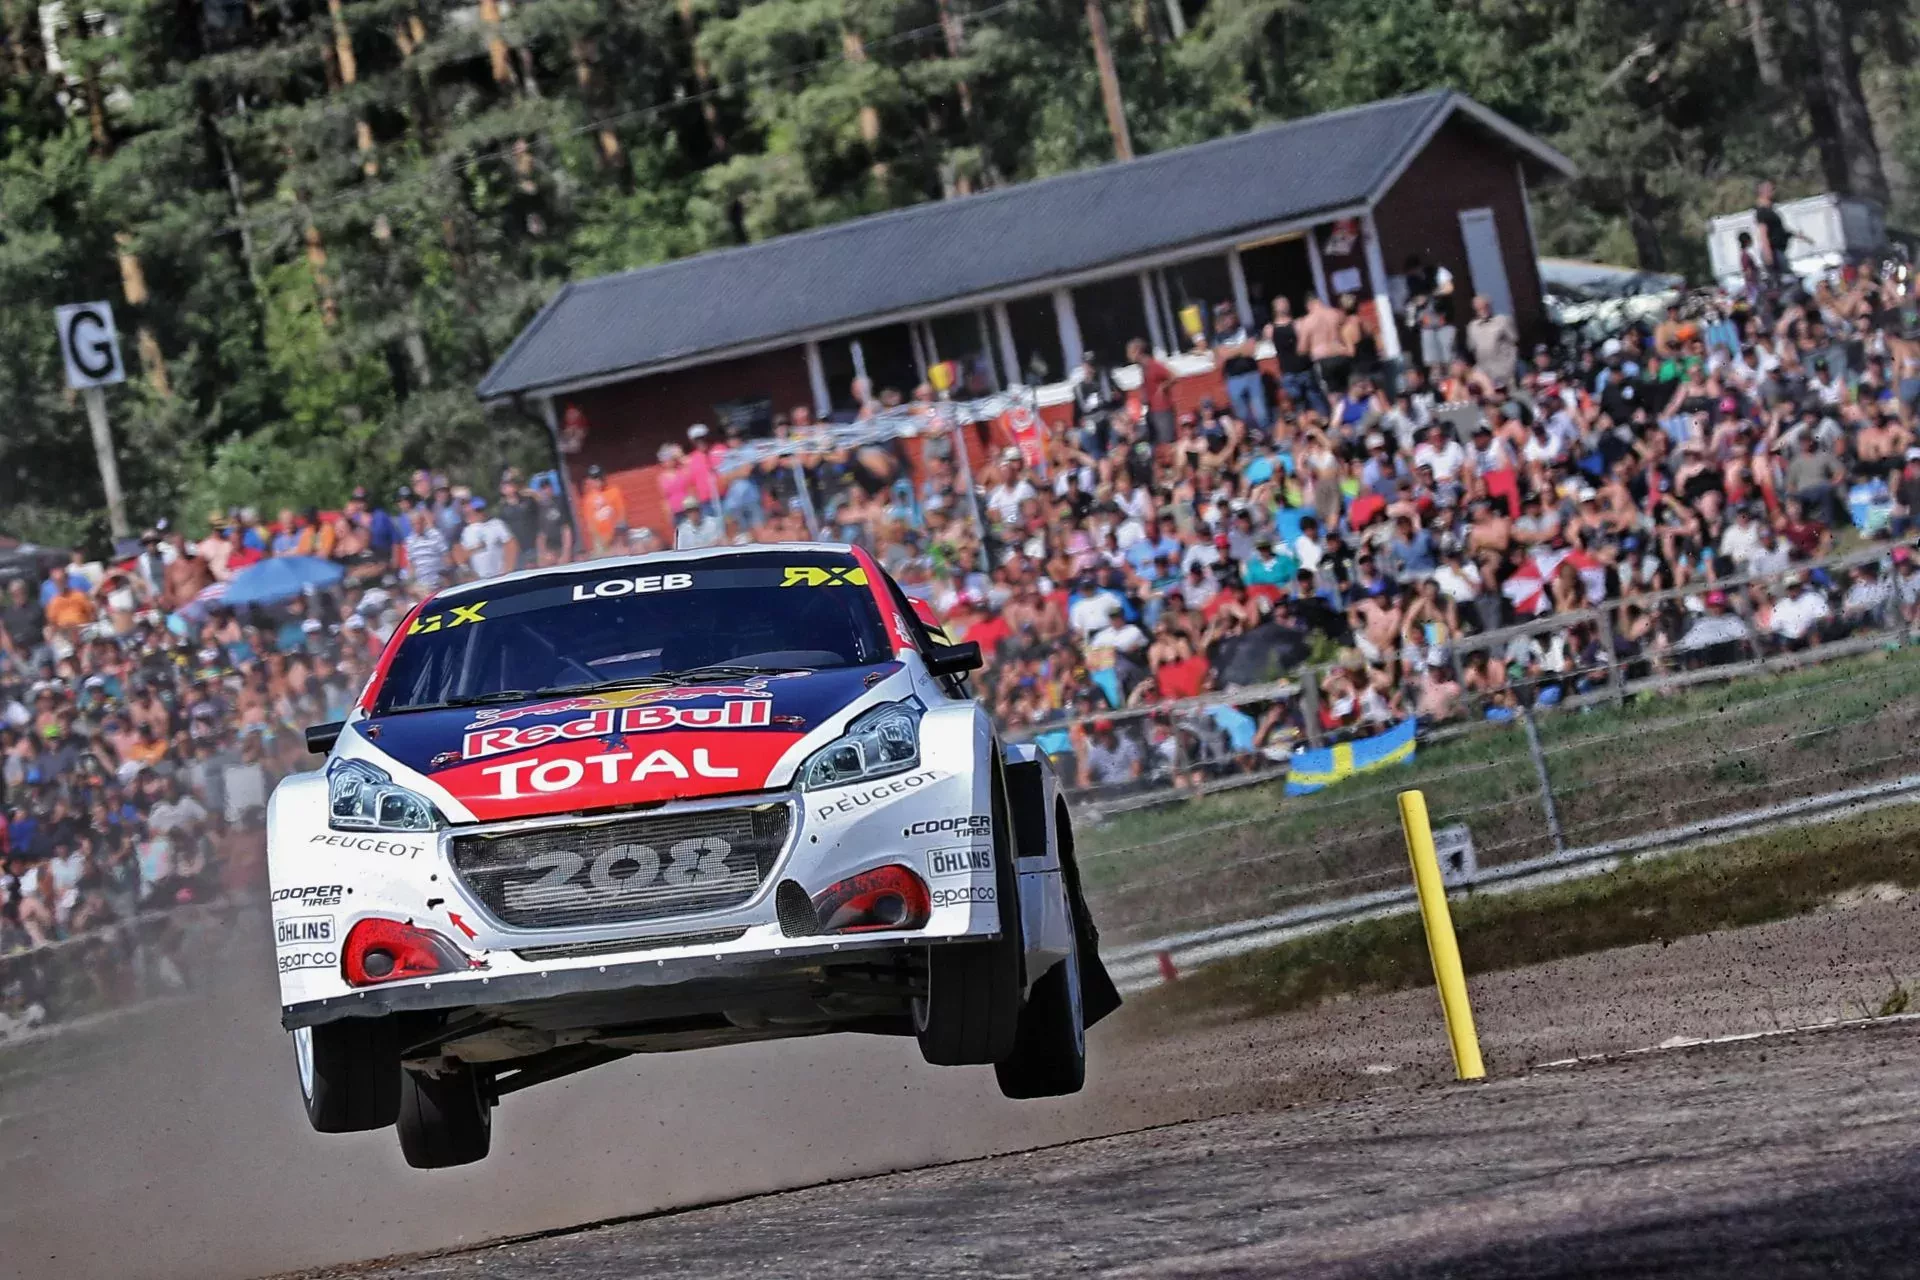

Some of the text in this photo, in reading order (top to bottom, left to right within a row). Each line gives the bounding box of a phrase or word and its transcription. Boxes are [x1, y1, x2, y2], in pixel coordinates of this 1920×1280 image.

[69, 311, 114, 378] G
[573, 573, 692, 600] LOEB
[463, 700, 771, 760] Red Bull
[482, 749, 738, 800] TOTAL
[818, 770, 938, 820] PEUGEOT
[911, 815, 990, 836] COOPER
[954, 827, 990, 839] TIRES
[310, 834, 425, 859] PEUGEOT
[513, 837, 731, 910] 208
[933, 850, 990, 874] ÖHLINS
[272, 885, 343, 902] COOPER
[302, 897, 341, 907] TIRES
[932, 887, 995, 907] sparco
[278, 921, 331, 943] ÖHLINS
[279, 952, 337, 972] sparco
